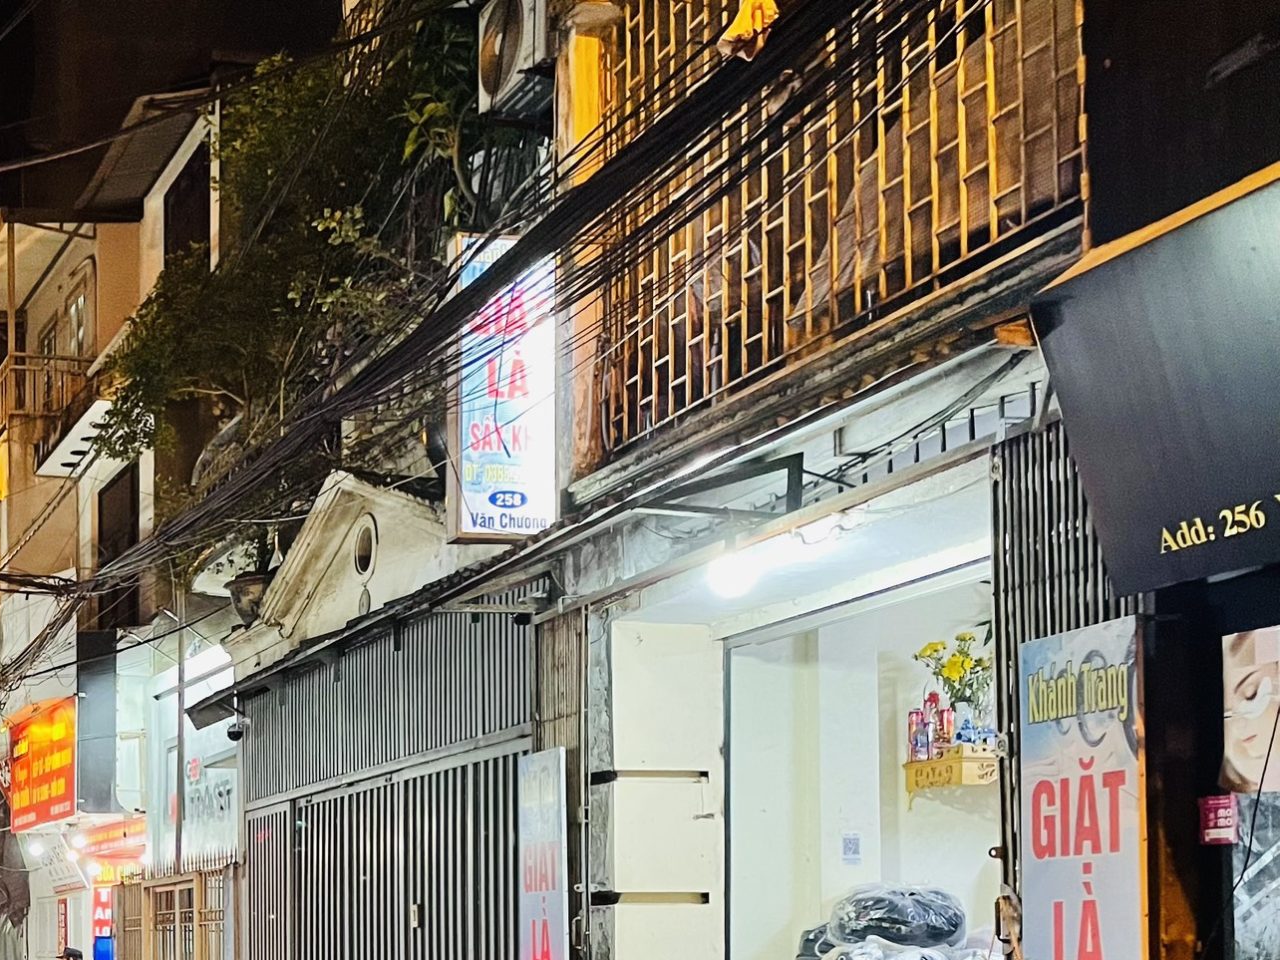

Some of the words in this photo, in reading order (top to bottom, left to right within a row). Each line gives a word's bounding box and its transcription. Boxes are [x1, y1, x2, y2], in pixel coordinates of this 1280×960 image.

[471, 512, 495, 529] Văn
[495, 493, 523, 507] 258
[1160, 517, 1216, 554] Add:
[1219, 500, 1266, 537] 256
[1027, 661, 1077, 725] Khánh
[1081, 660, 1129, 723] Trang
[1031, 756, 1127, 875] GIẶT
